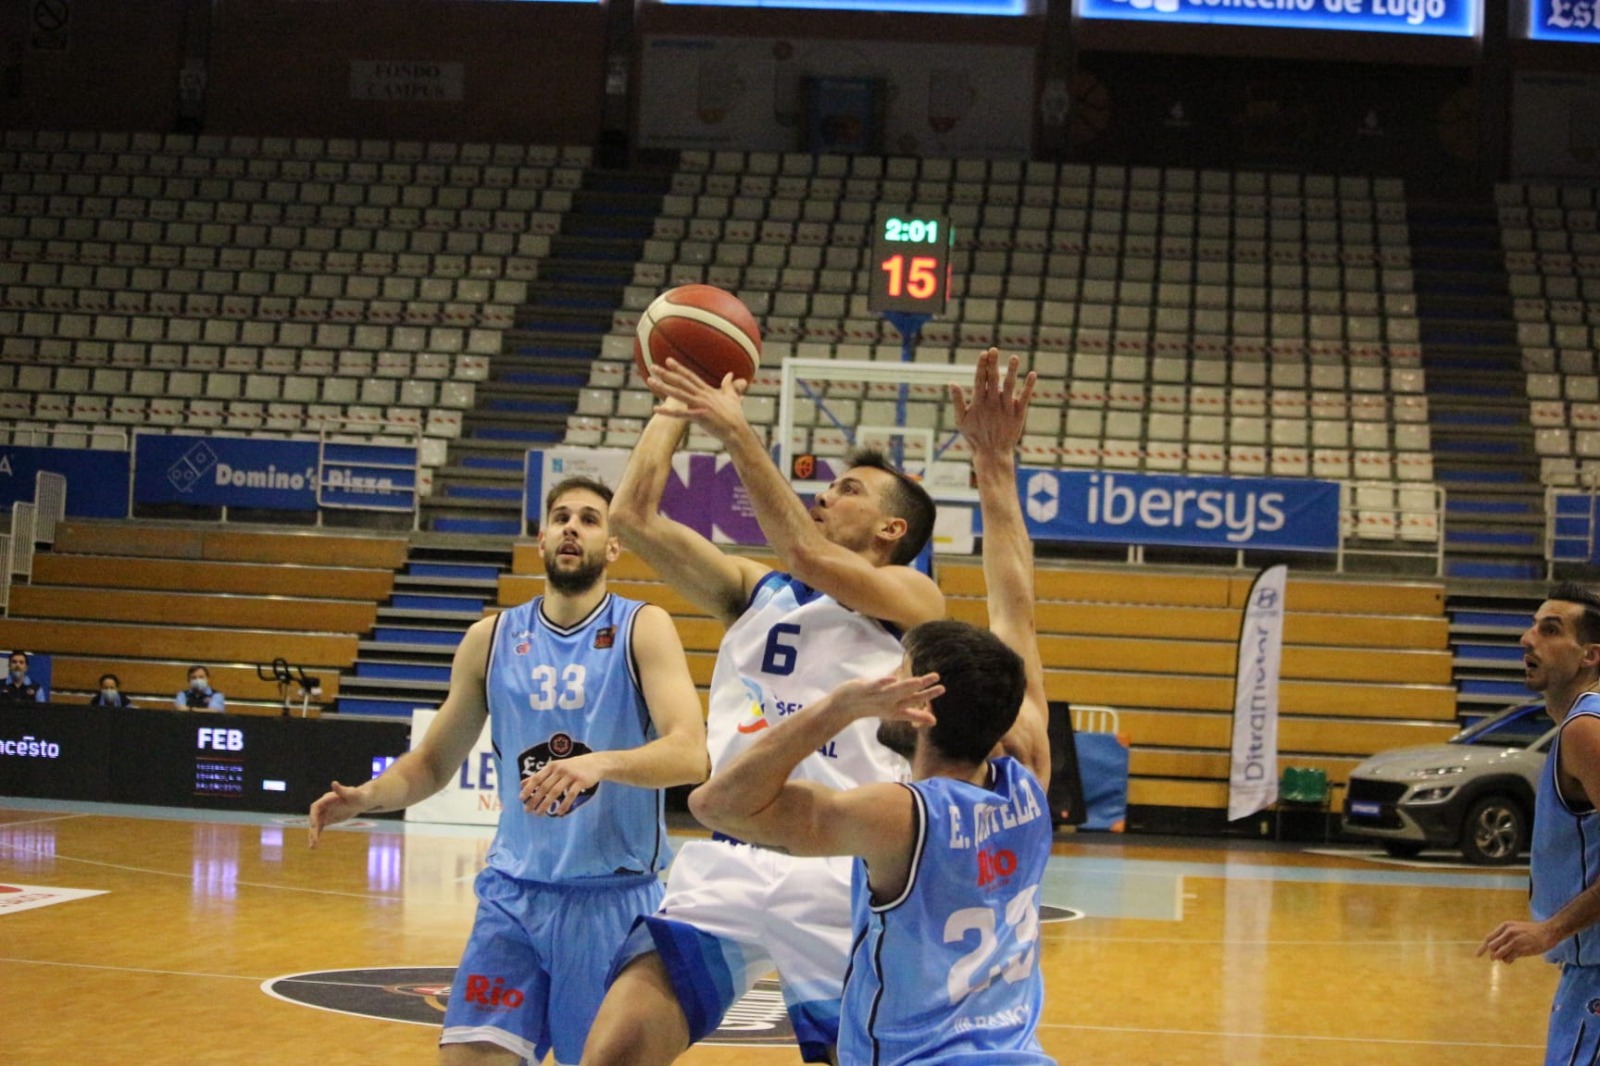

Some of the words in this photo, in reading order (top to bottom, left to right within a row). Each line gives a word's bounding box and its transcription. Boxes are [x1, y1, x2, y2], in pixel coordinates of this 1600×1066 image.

[1372, 0, 1446, 25] Lugo
[375, 63, 441, 78] FONDO
[885, 218, 938, 244] 2:01
[881, 254, 938, 299] 15
[215, 463, 317, 491] Domino's
[328, 469, 393, 495] Pizza
[1087, 474, 1285, 542] ibersys
[761, 622, 801, 676] 6
[529, 664, 586, 711] 33
[197, 727, 244, 751] FEB
[949, 804, 970, 849] E.
[465, 974, 524, 1009] Rio
